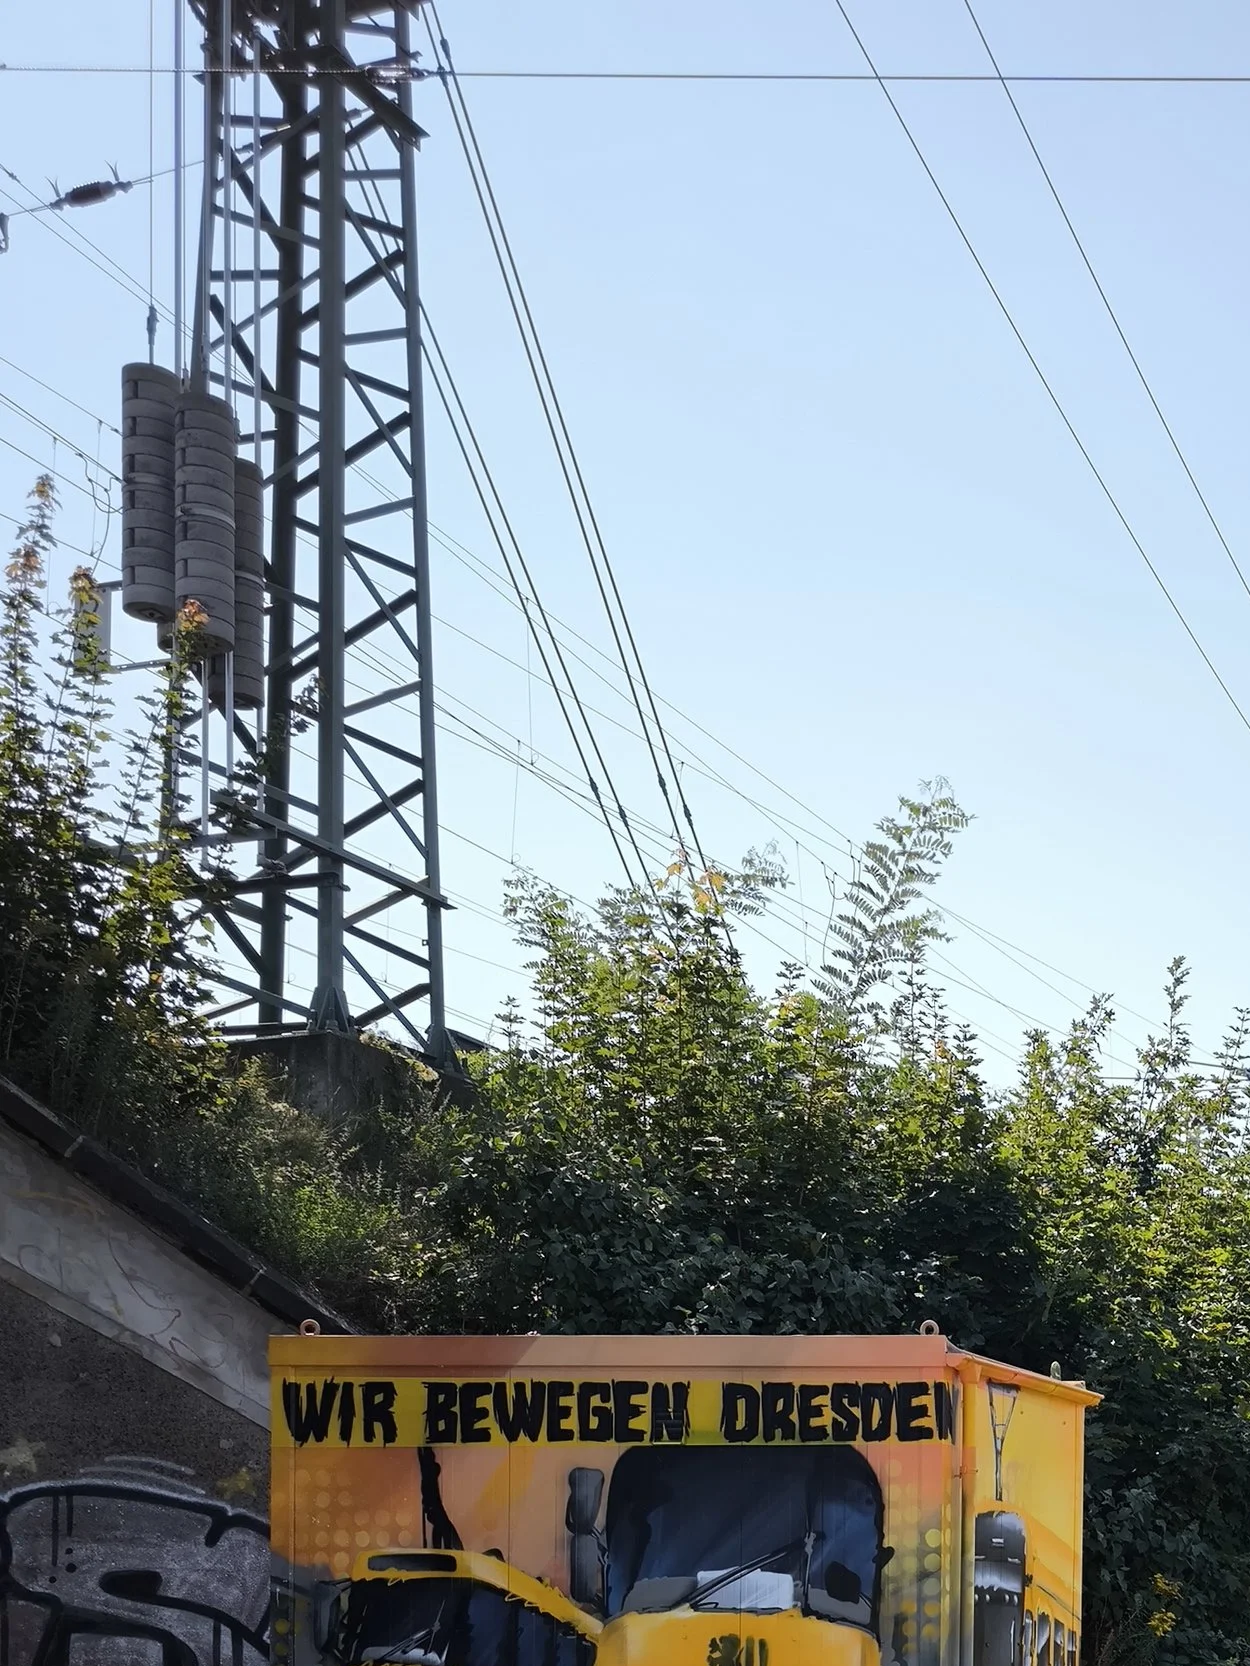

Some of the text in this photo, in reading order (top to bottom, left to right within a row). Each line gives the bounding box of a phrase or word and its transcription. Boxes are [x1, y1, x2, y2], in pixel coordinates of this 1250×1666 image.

[283, 1376, 960, 1447] WIR BEWEGEN DRESDEN
